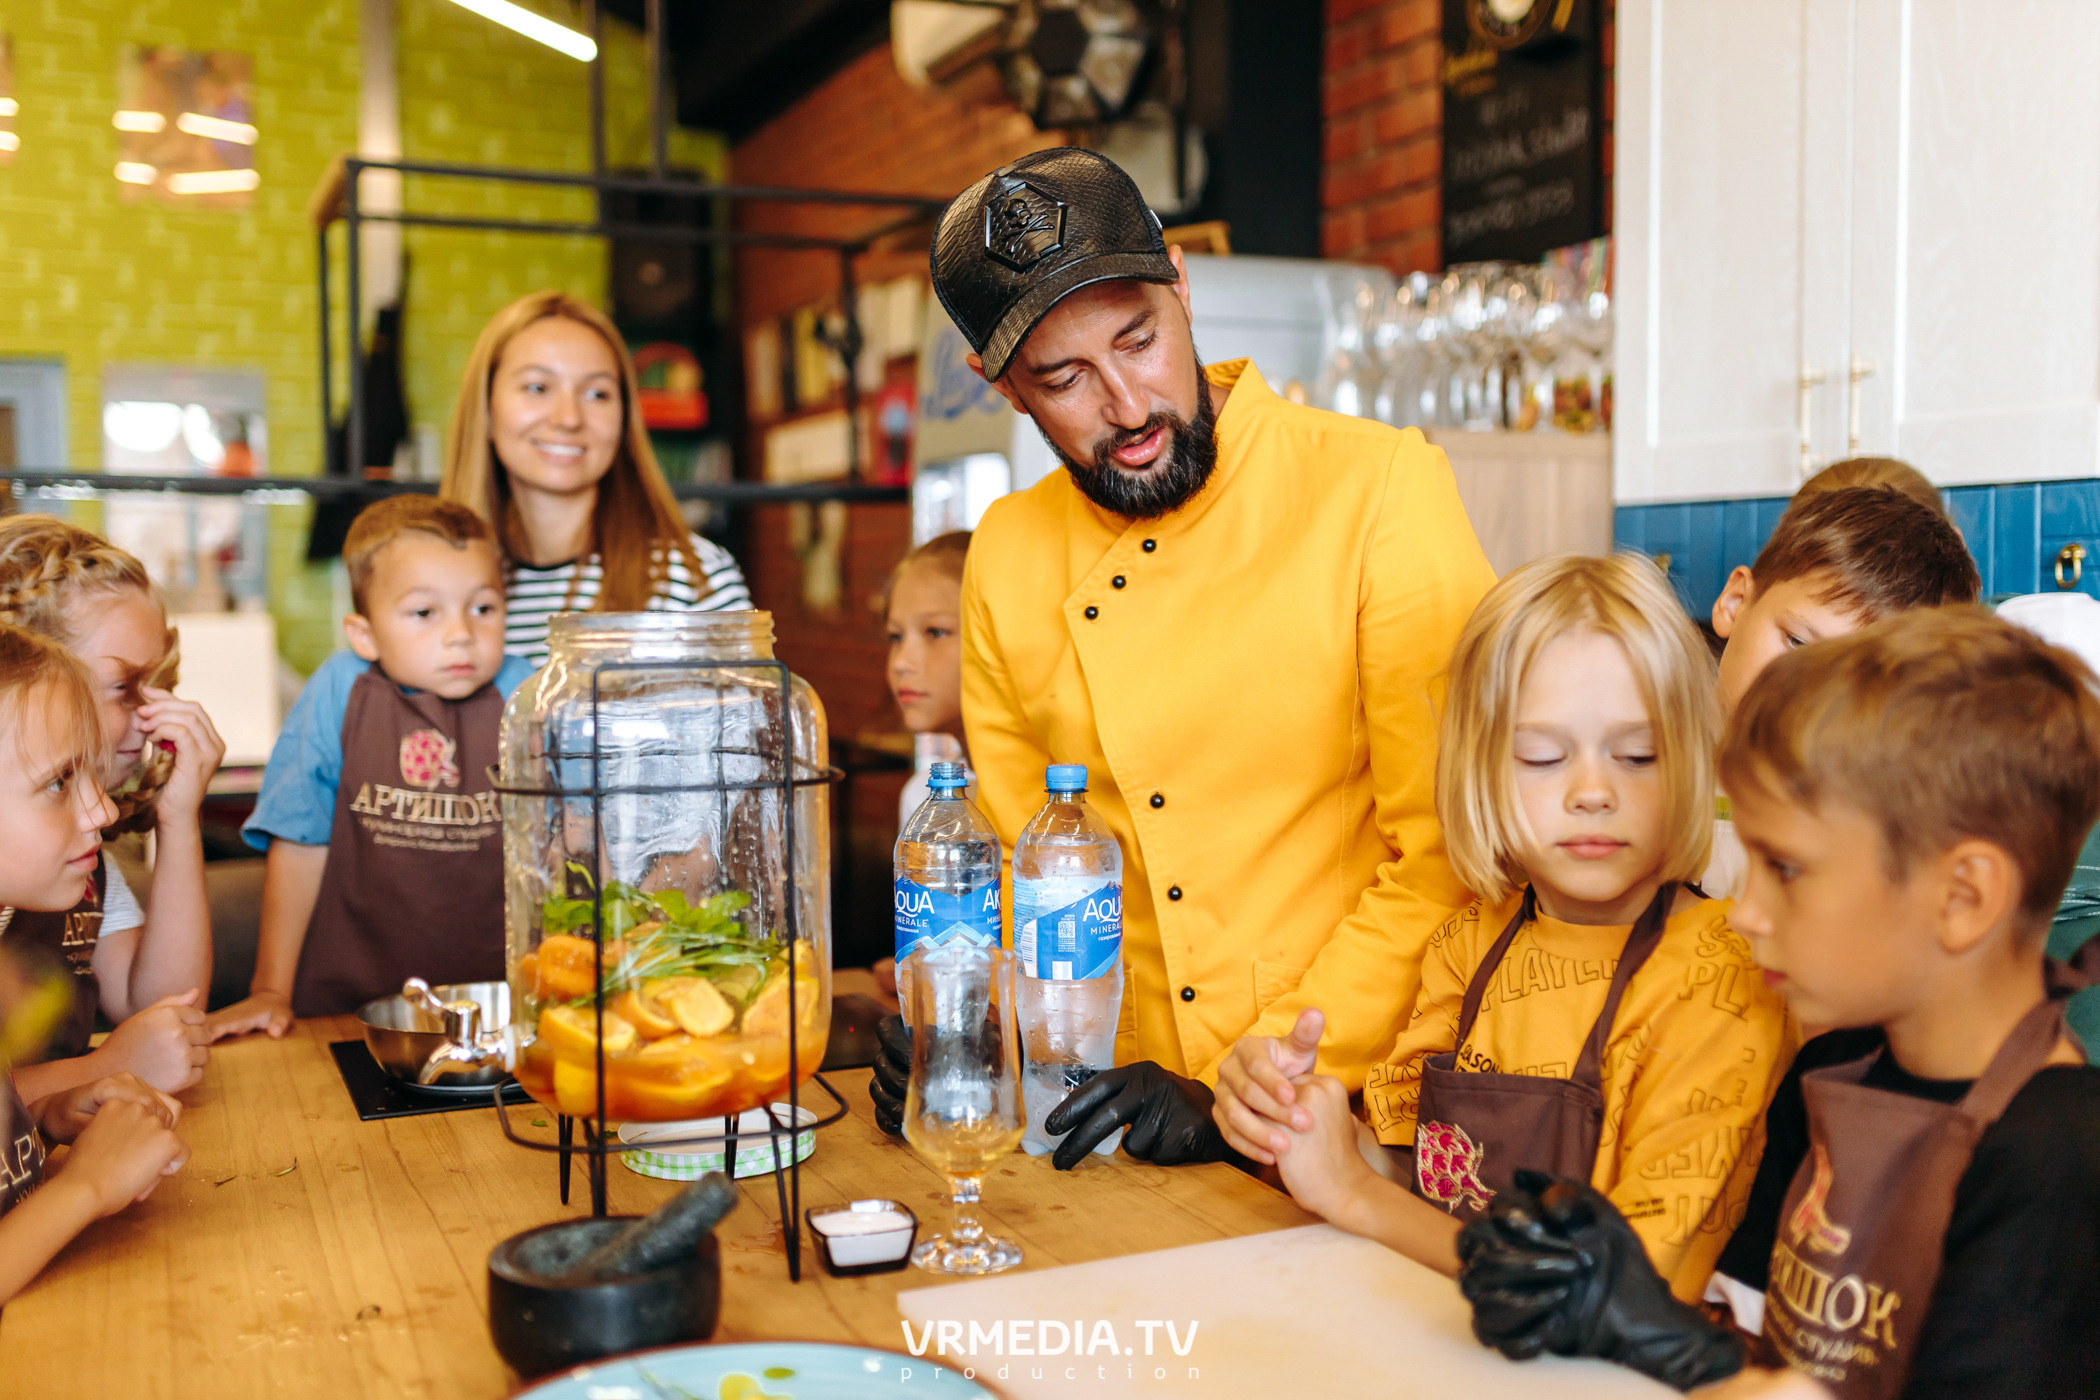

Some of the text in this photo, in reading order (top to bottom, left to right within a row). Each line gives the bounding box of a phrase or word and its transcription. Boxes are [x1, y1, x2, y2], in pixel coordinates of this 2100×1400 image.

[350, 782, 502, 826] АРТИШОК
[895, 890, 935, 918] QUA
[1082, 896, 1122, 924] AQU
